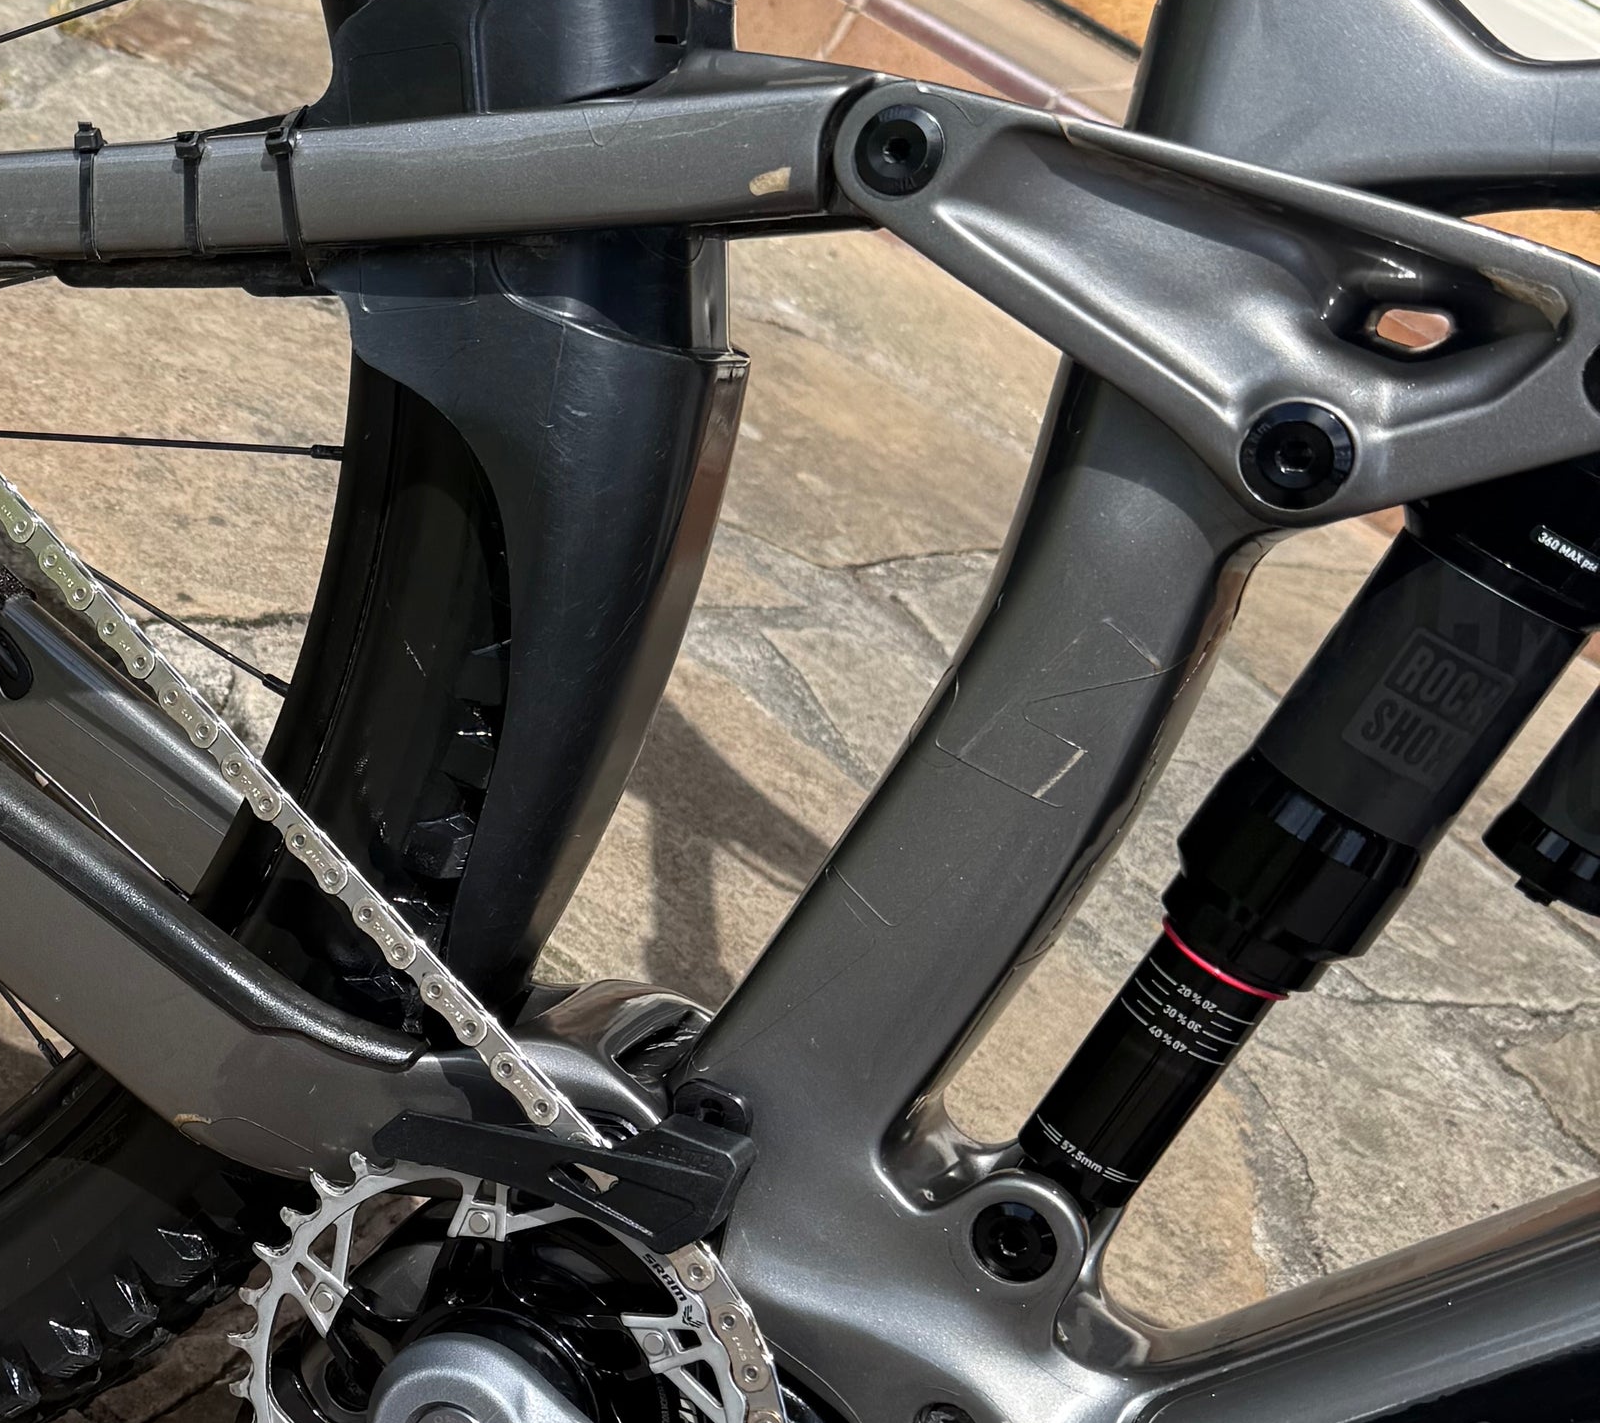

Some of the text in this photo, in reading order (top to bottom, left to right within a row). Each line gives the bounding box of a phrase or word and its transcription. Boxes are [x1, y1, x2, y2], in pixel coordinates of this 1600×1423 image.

[1537, 530, 1560, 552] 360
[1558, 543, 1584, 564] MAX
[1398, 644, 1500, 726] ROCK
[1177, 984, 1192, 999] 20
[1163, 1004, 1177, 1019] 30
[1149, 1025, 1163, 1039] 40
[1060, 1139, 1103, 1174] 57.5mm
[642, 1253, 687, 1301] SRAM
